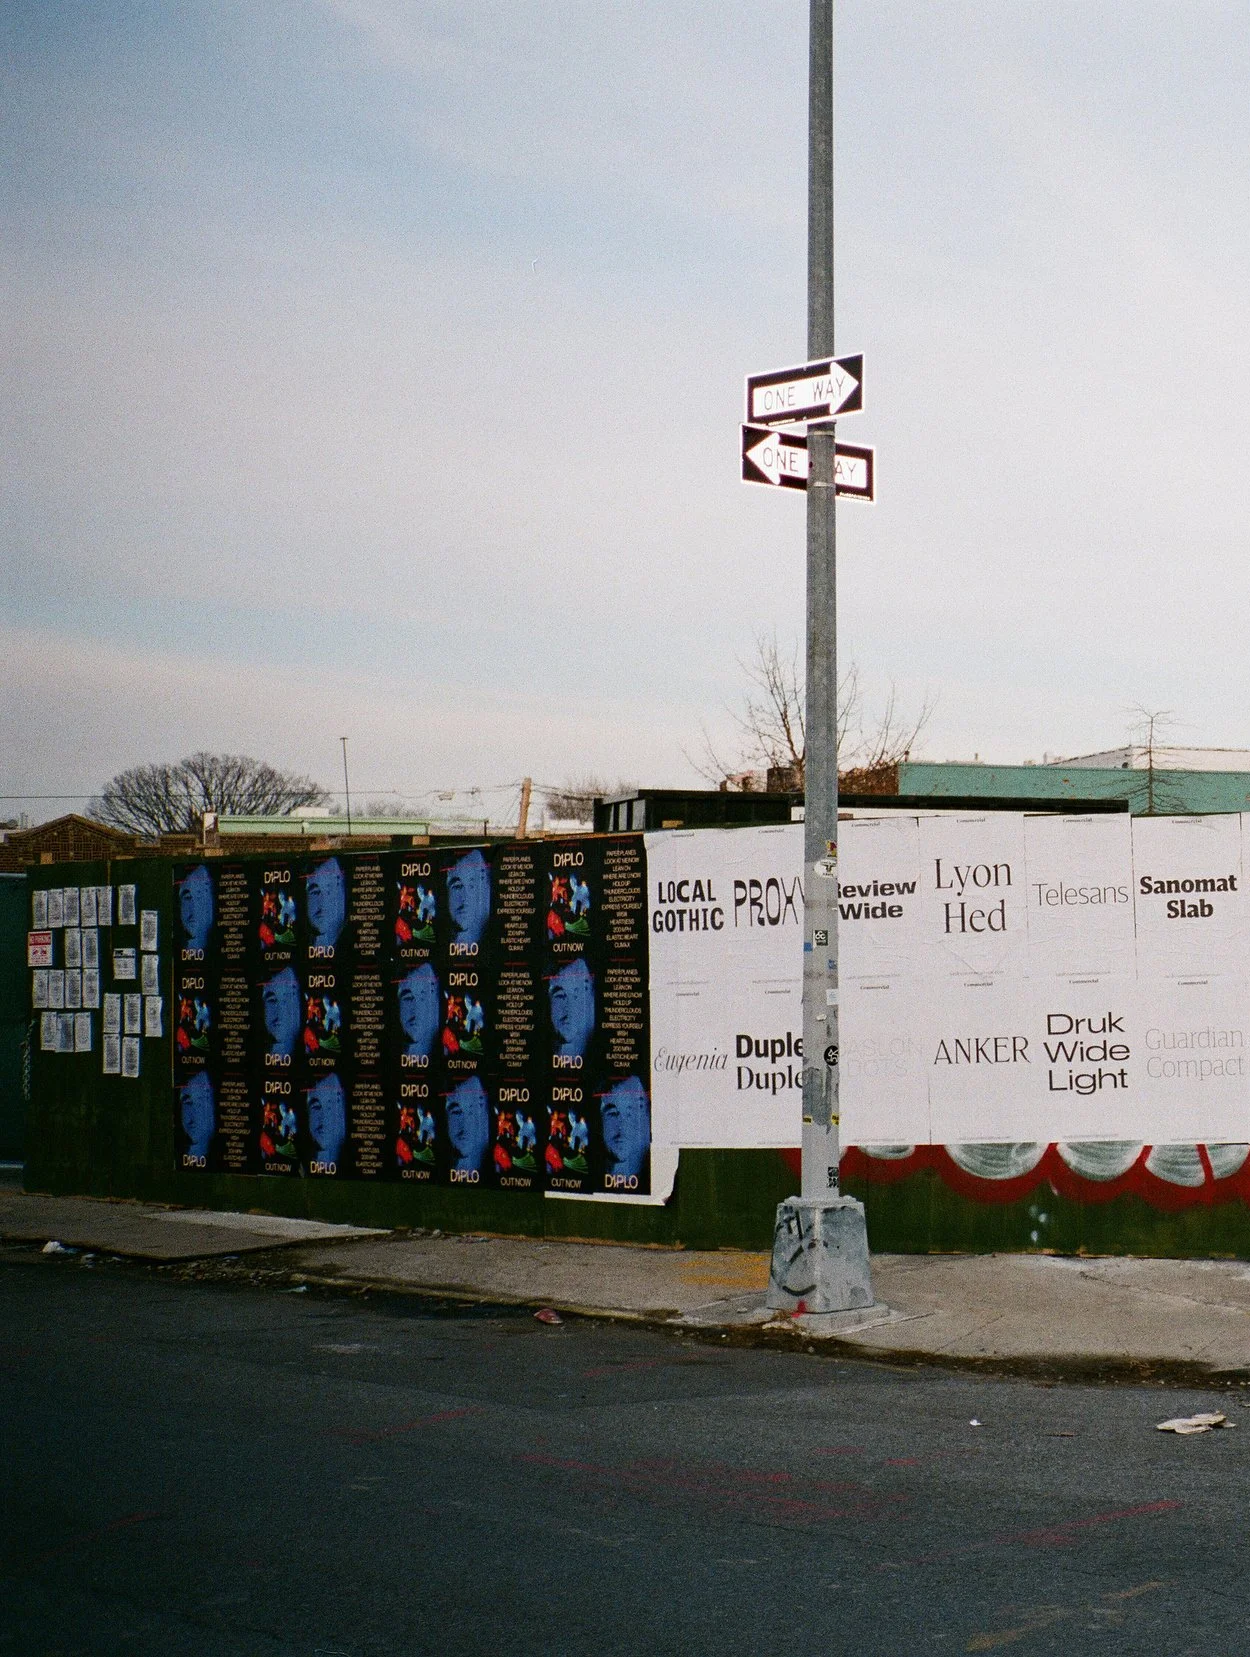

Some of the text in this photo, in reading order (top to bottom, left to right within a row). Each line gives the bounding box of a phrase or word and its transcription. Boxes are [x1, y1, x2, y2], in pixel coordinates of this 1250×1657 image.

[764, 376, 846, 410] ONE WAY
[763, 447, 857, 481] ONE AY
[554, 852, 584, 867] DIPLO
[402, 863, 430, 876] DIPLO
[264, 870, 290, 884] DIPLO
[934, 858, 1013, 896] Lyon
[658, 878, 716, 904] LOCAL
[1140, 874, 1238, 895] Sanomat
[1032, 882, 1129, 906] Telesans
[838, 902, 904, 920] Wide
[1167, 900, 1214, 918] Slab
[652, 907, 724, 933] GOTHIC
[943, 900, 1008, 933] Hed
[308, 946, 334, 958] DIPLO
[400, 949, 430, 958] OUT NOW
[450, 942, 478, 956] DIPLO
[553, 942, 584, 952] OUT NOW
[182, 949, 204, 960] DIPLO
[265, 952, 290, 961] OUT NOW
[182, 978, 204, 990] DIPLO
[308, 974, 335, 988] DIPLO
[450, 972, 478, 986] DIPLO
[1047, 1012, 1125, 1036] Druk
[1145, 1026, 1244, 1050] Guardian
[736, 1032, 804, 1064] Duple
[934, 1035, 1031, 1065] ANKER
[1043, 1040, 1130, 1064] Wide
[182, 1056, 205, 1065] OUT NOW
[265, 1054, 291, 1066] DIPLO
[309, 1058, 336, 1067] OUT NOW
[402, 1054, 428, 1068] DIPLO
[448, 1060, 478, 1070] OUT NOW
[552, 1054, 583, 1069] DIPLO
[654, 1046, 728, 1076] Eugenia
[1146, 1056, 1244, 1081] Compact
[736, 1064, 803, 1096] Duple
[1048, 1067, 1128, 1095] Light
[265, 1082, 292, 1094] DIPLO
[402, 1084, 428, 1098] DIPLO
[500, 1088, 530, 1102] DIPLO
[552, 1088, 583, 1102] DIPLO
[183, 1154, 206, 1168] DIPLO
[265, 1162, 292, 1173] OUT NOW
[310, 1161, 336, 1174] DIPLO
[402, 1170, 430, 1180] OUT NOW
[450, 1170, 480, 1184] DIPLO
[605, 1174, 638, 1190] DIPLO
[501, 1178, 532, 1188] OUT NOW
[552, 1178, 582, 1188] OUT NOW
